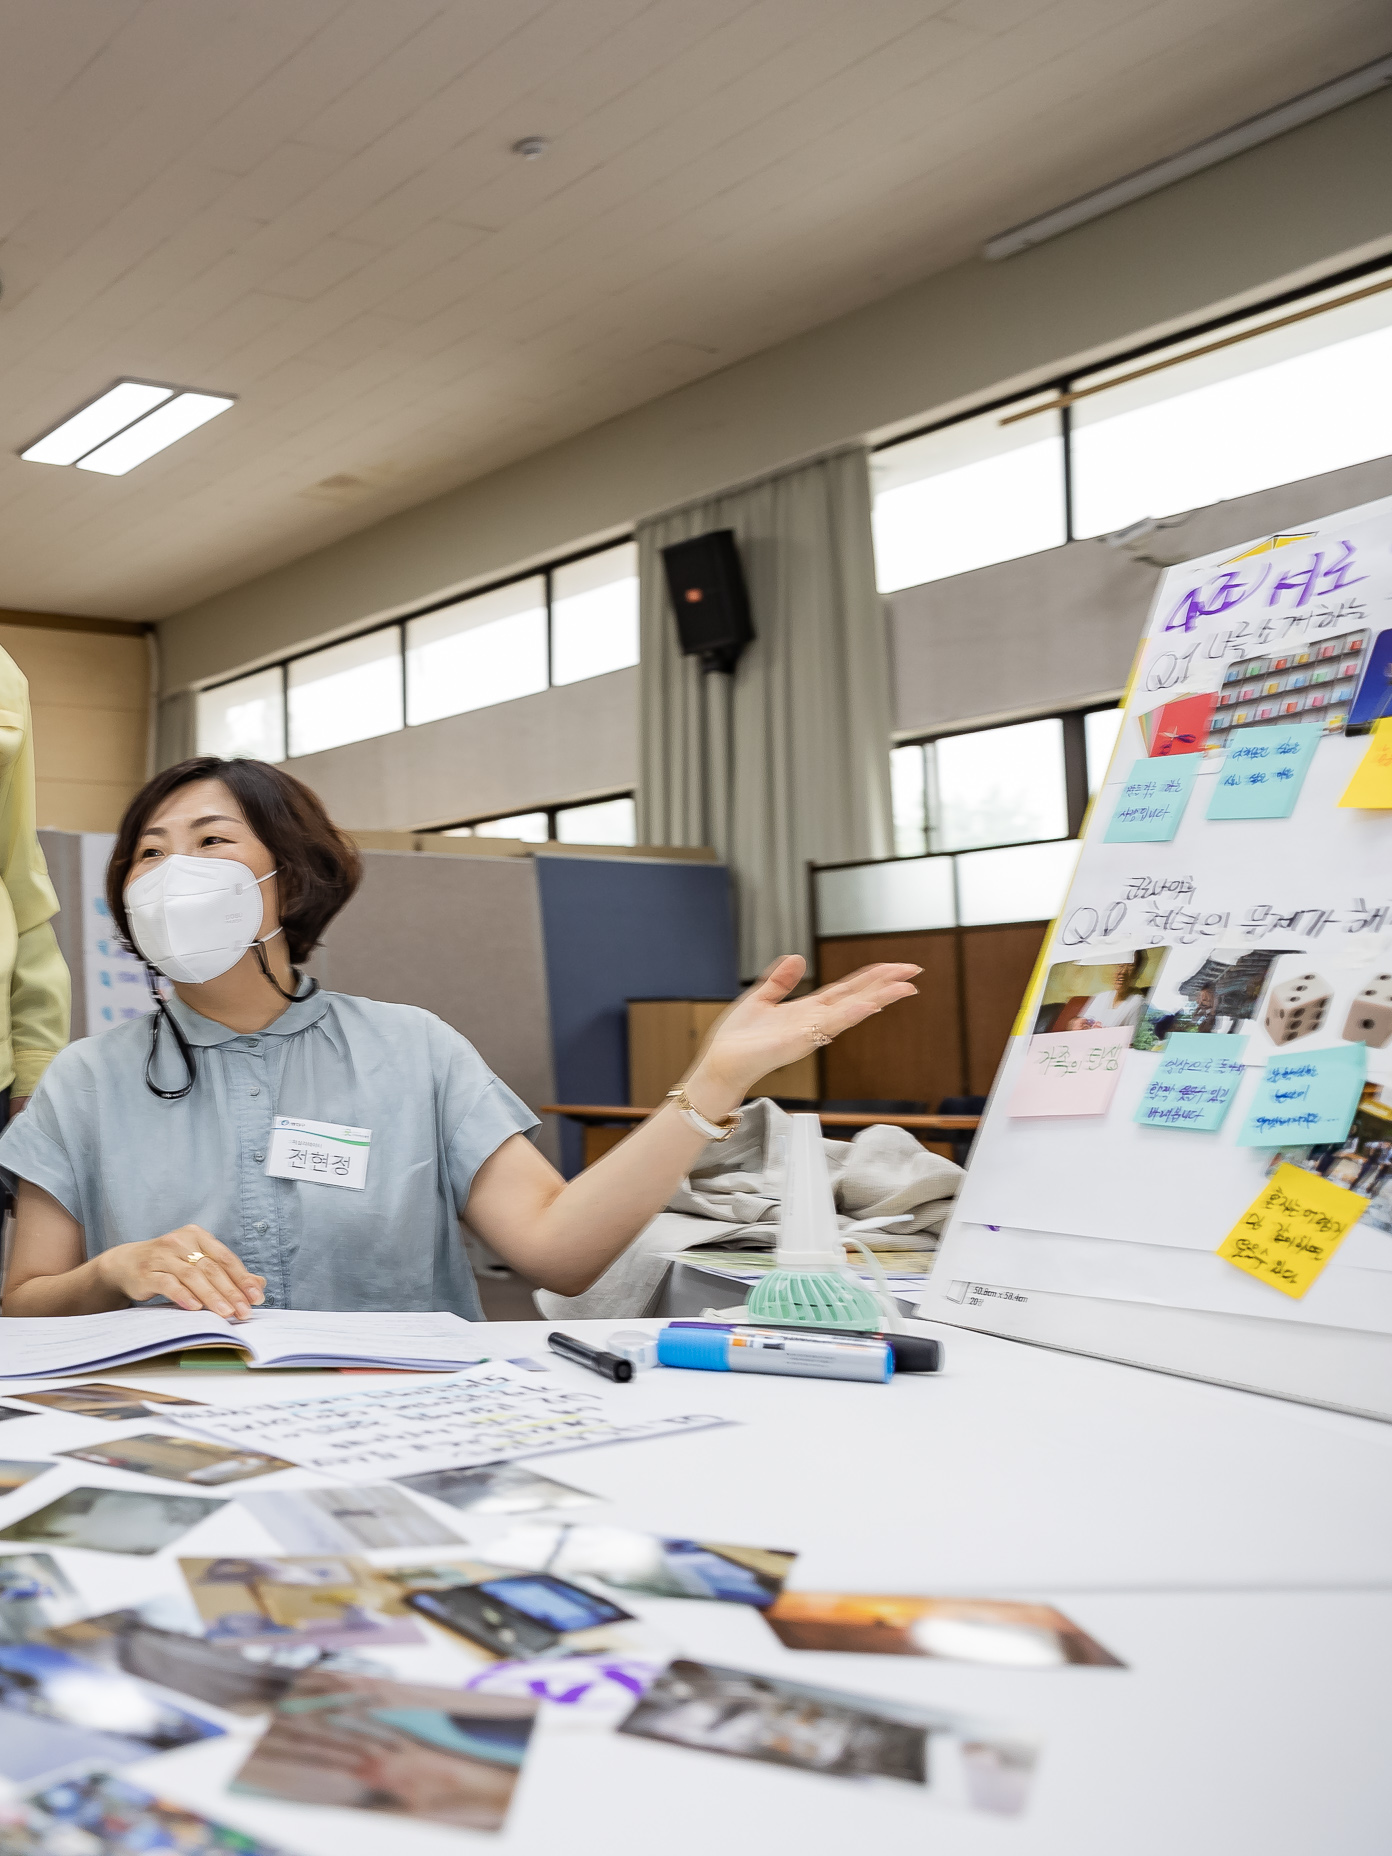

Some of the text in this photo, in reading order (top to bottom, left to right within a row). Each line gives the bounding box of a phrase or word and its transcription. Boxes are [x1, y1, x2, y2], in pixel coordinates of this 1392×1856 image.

[1208, 621, 1250, 659] 나를
[1140, 900, 1231, 945] 청년의
[1236, 904, 1341, 939] 문제가
[1039, 1043, 1123, 1077] 가족의 탄생
[287, 1148, 351, 1176] 전현정
